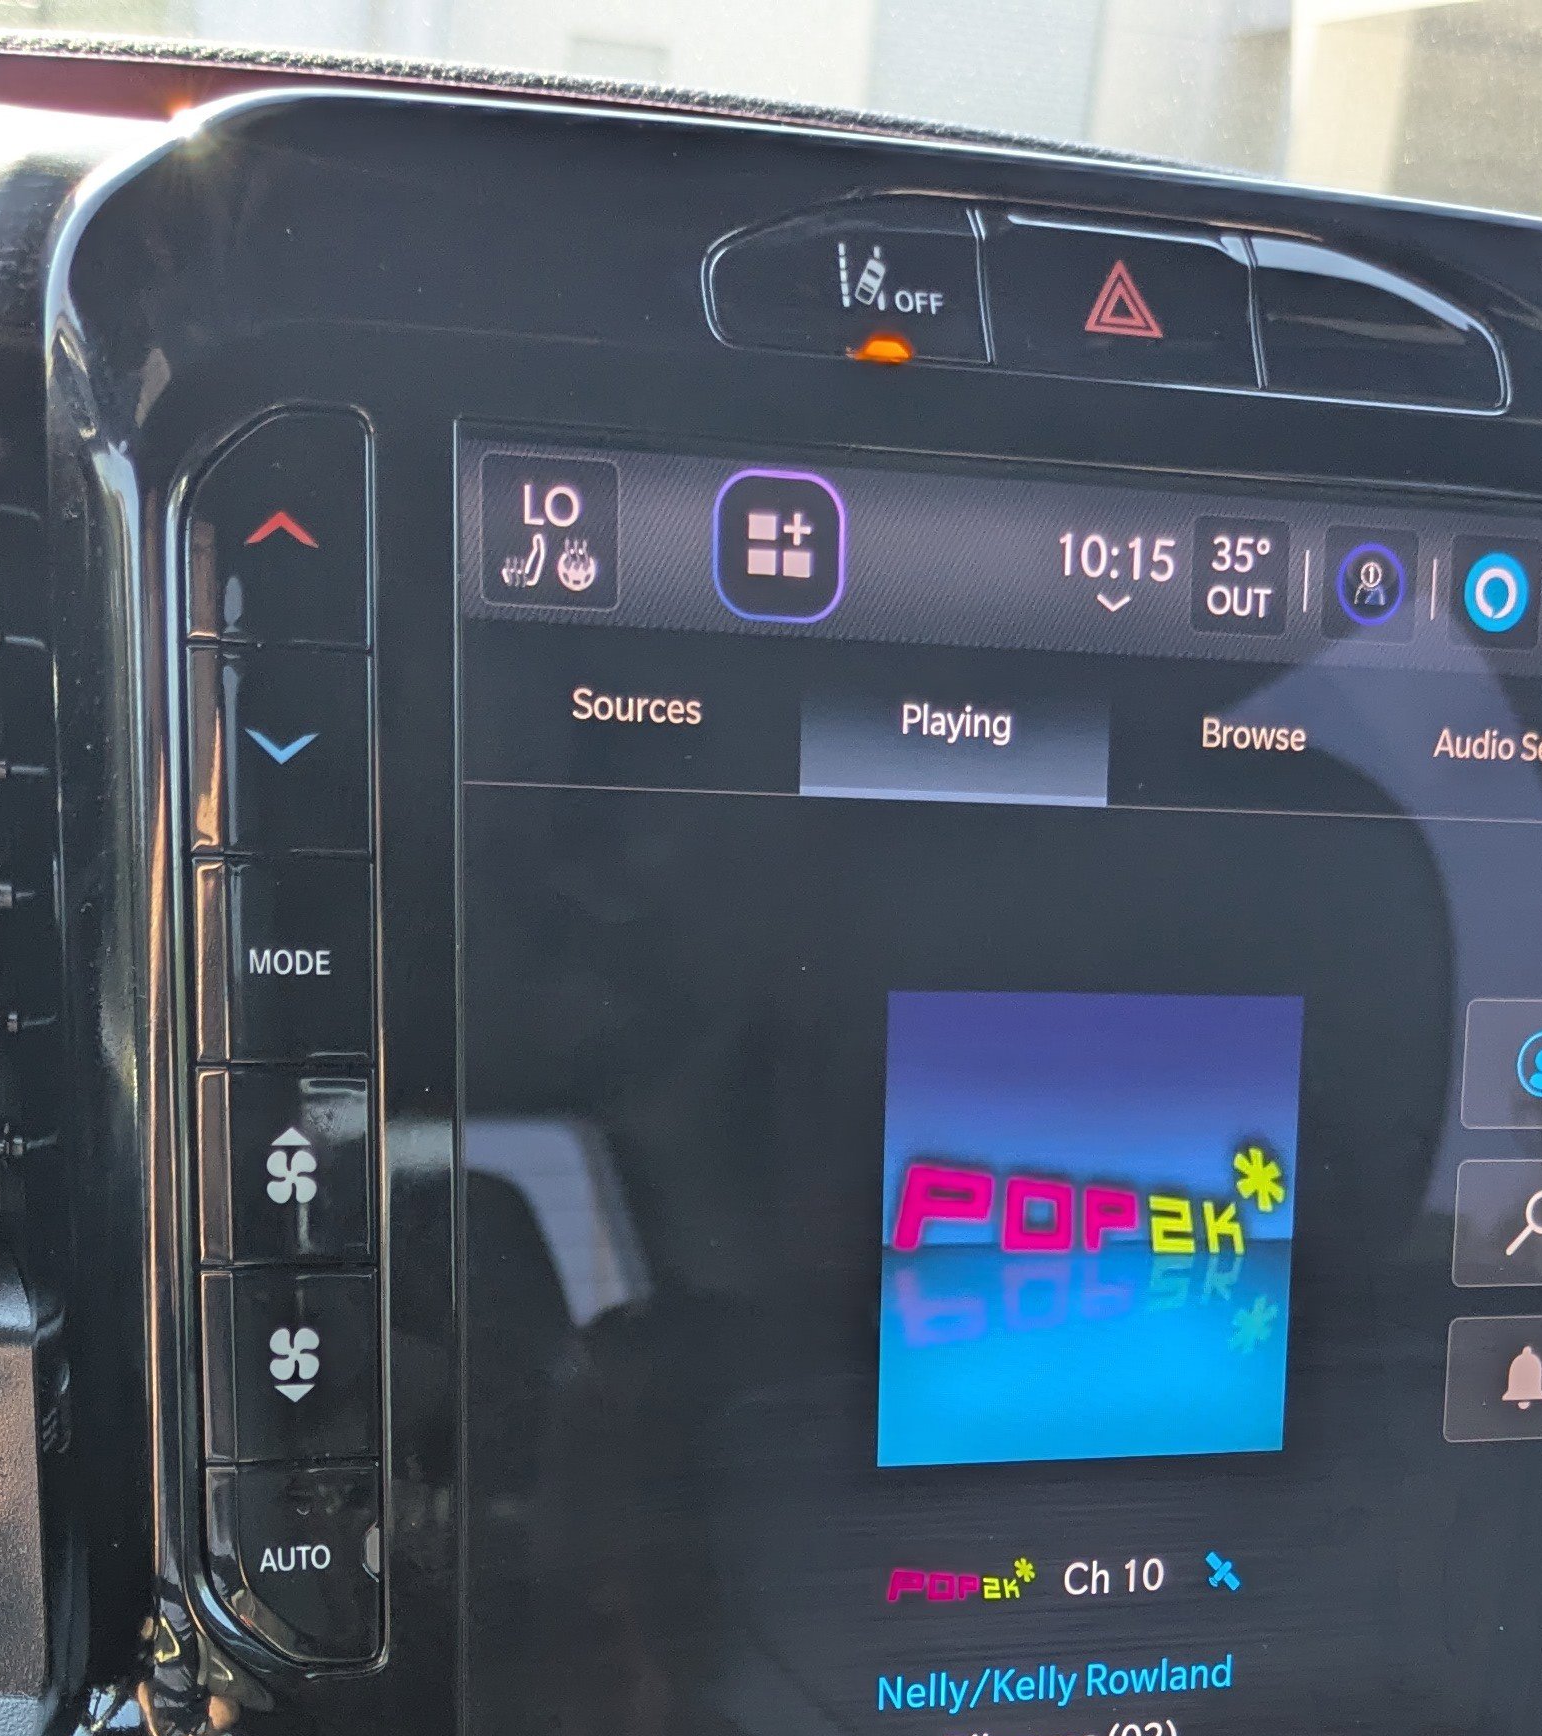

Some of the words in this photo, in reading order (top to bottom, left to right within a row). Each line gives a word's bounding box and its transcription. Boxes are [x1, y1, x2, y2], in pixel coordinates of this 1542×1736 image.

[895, 289, 944, 315] OFF
[523, 483, 580, 526] LO
[1059, 533, 1175, 582] 10:15
[1207, 587, 1271, 618] OUT
[572, 686, 702, 724] Sources
[902, 702, 1012, 746] Playing
[1202, 717, 1307, 752] Browse
[1433, 727, 1514, 762] Audio
[249, 949, 332, 976] MODE
[260, 1544, 331, 1573] AUTO
[1063, 1560, 1110, 1596] Ch
[1124, 1557, 1165, 1592] 10
[877, 1666, 1078, 1715] Nelly/Kelly
[1086, 1654, 1233, 1698] Rowland
